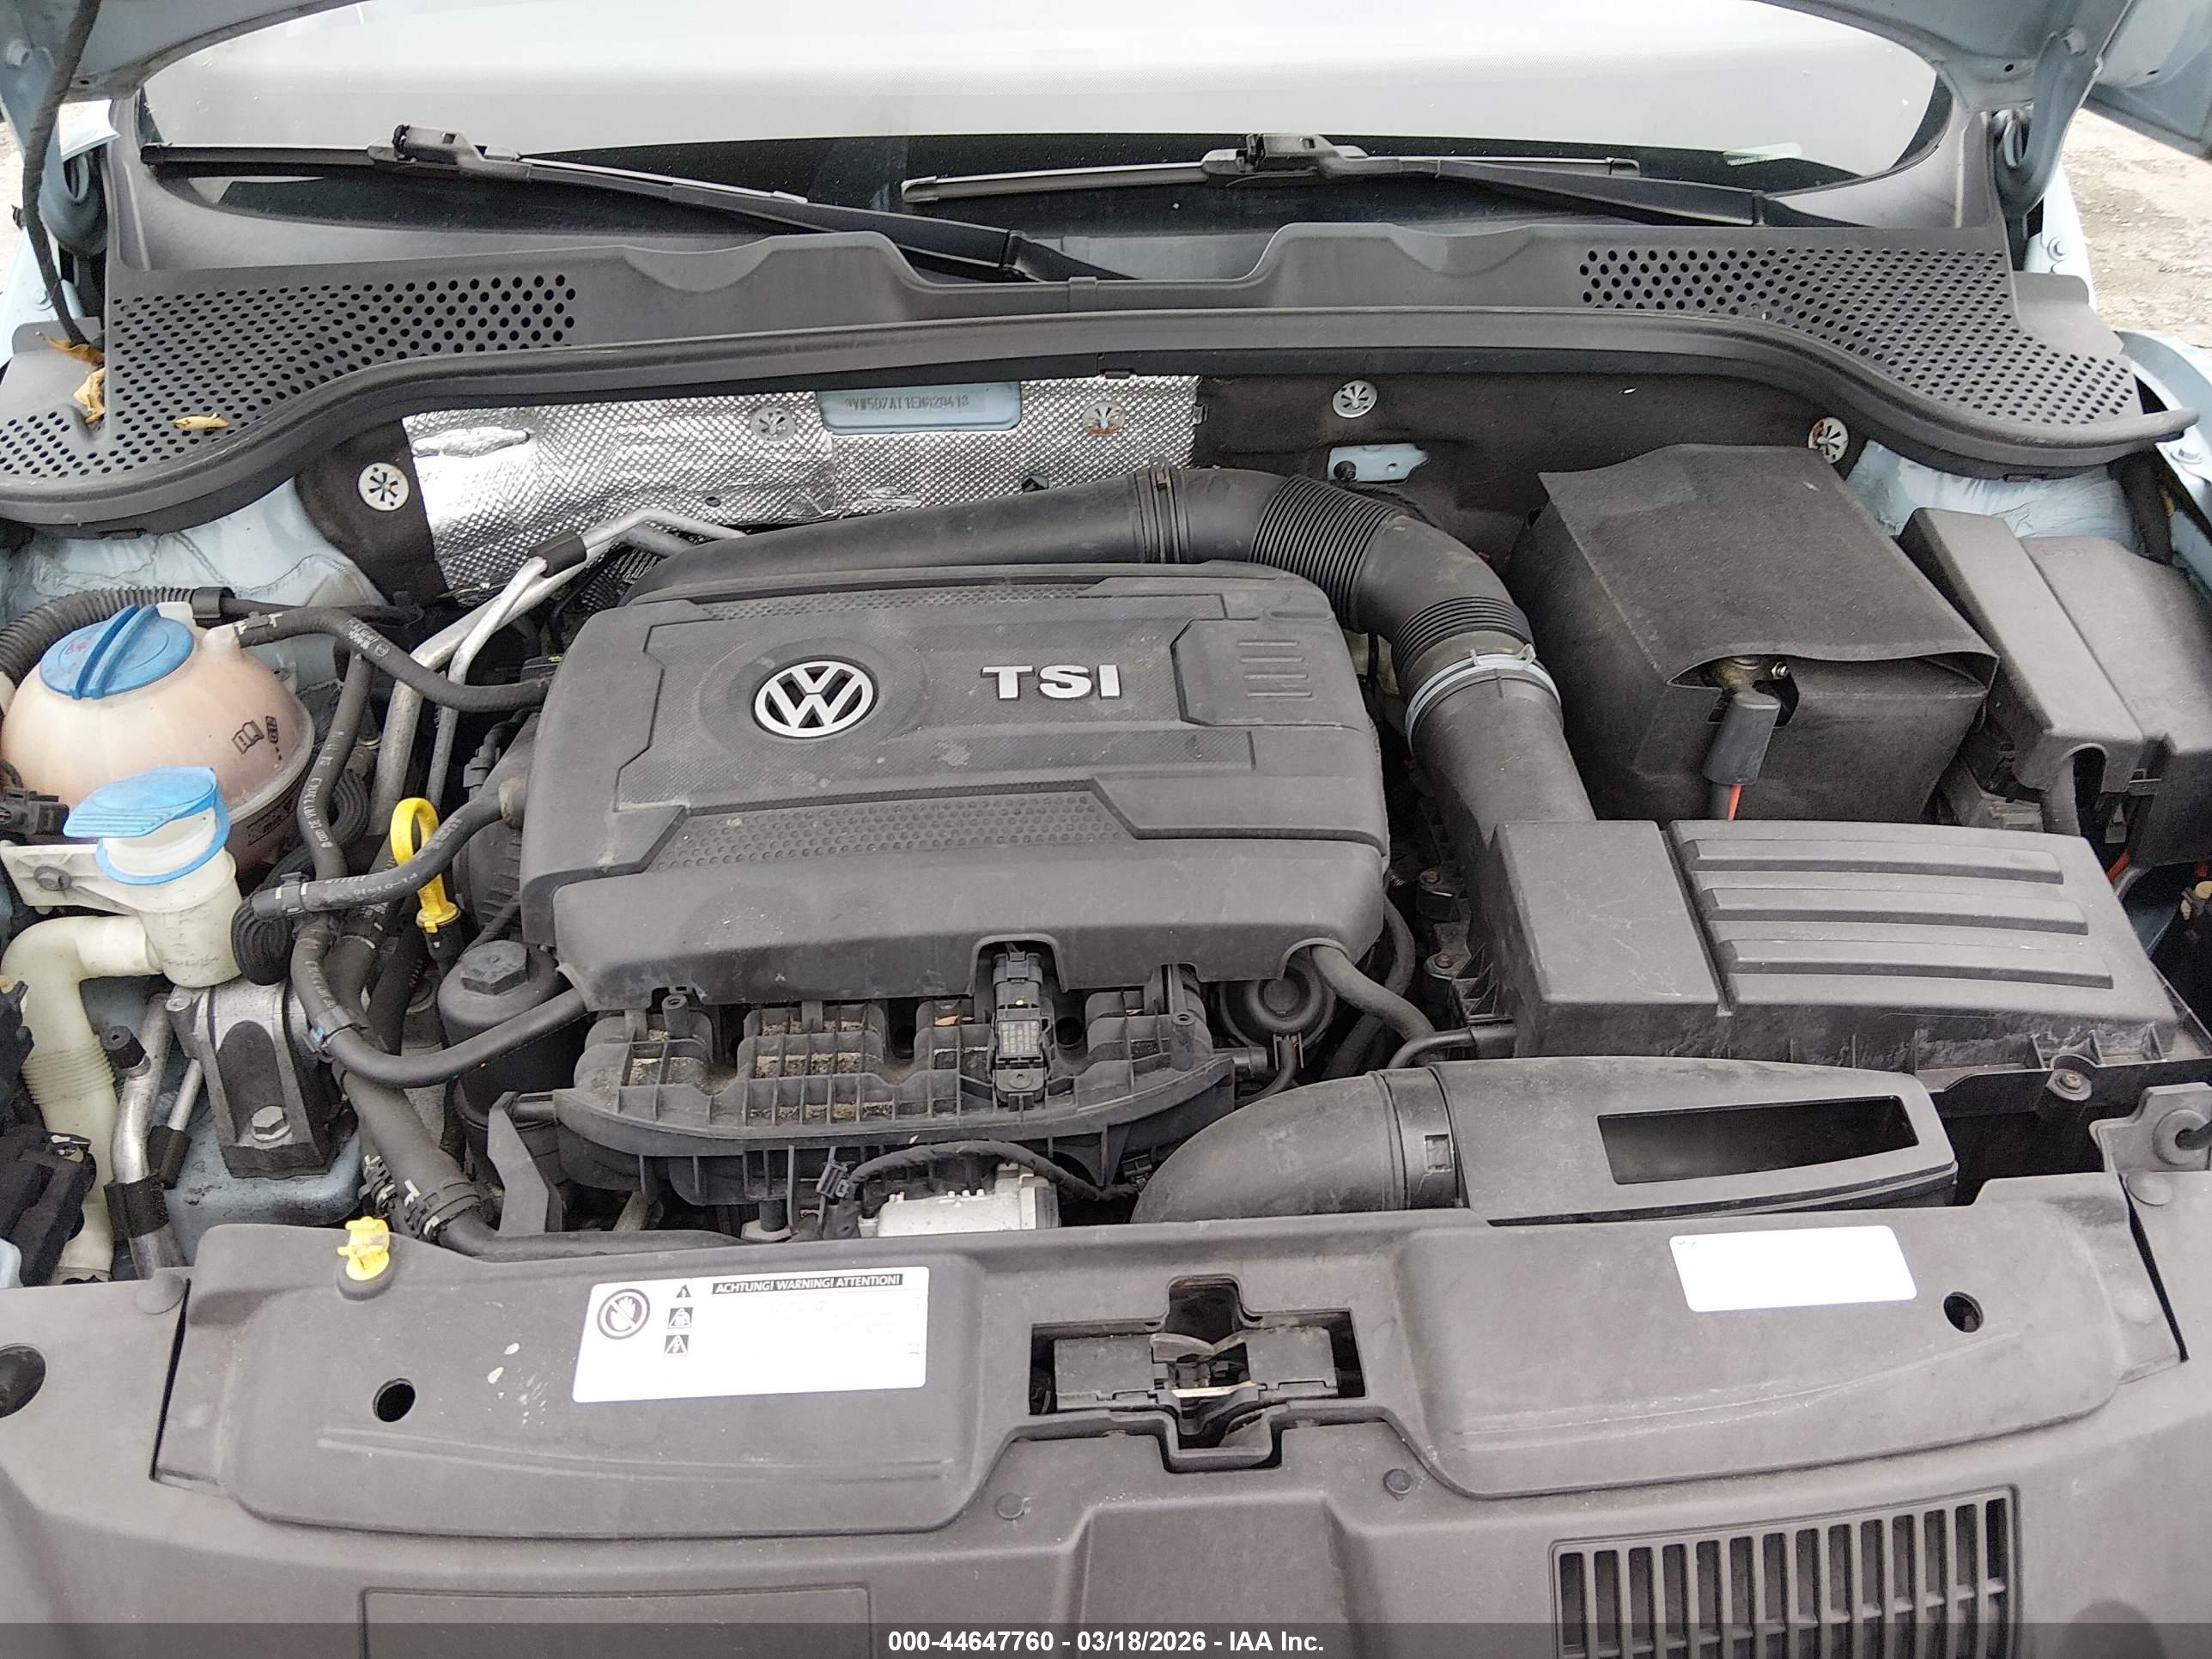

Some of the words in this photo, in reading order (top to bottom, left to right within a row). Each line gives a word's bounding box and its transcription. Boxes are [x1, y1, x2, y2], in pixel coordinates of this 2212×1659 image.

[755, 659, 875, 738] VW
[981, 664, 1121, 701] TSI
[714, 1281, 775, 1294] ACHTUNG!
[775, 1278, 835, 1291] WARNING!
[835, 1274, 902, 1286] ATTENTION!
